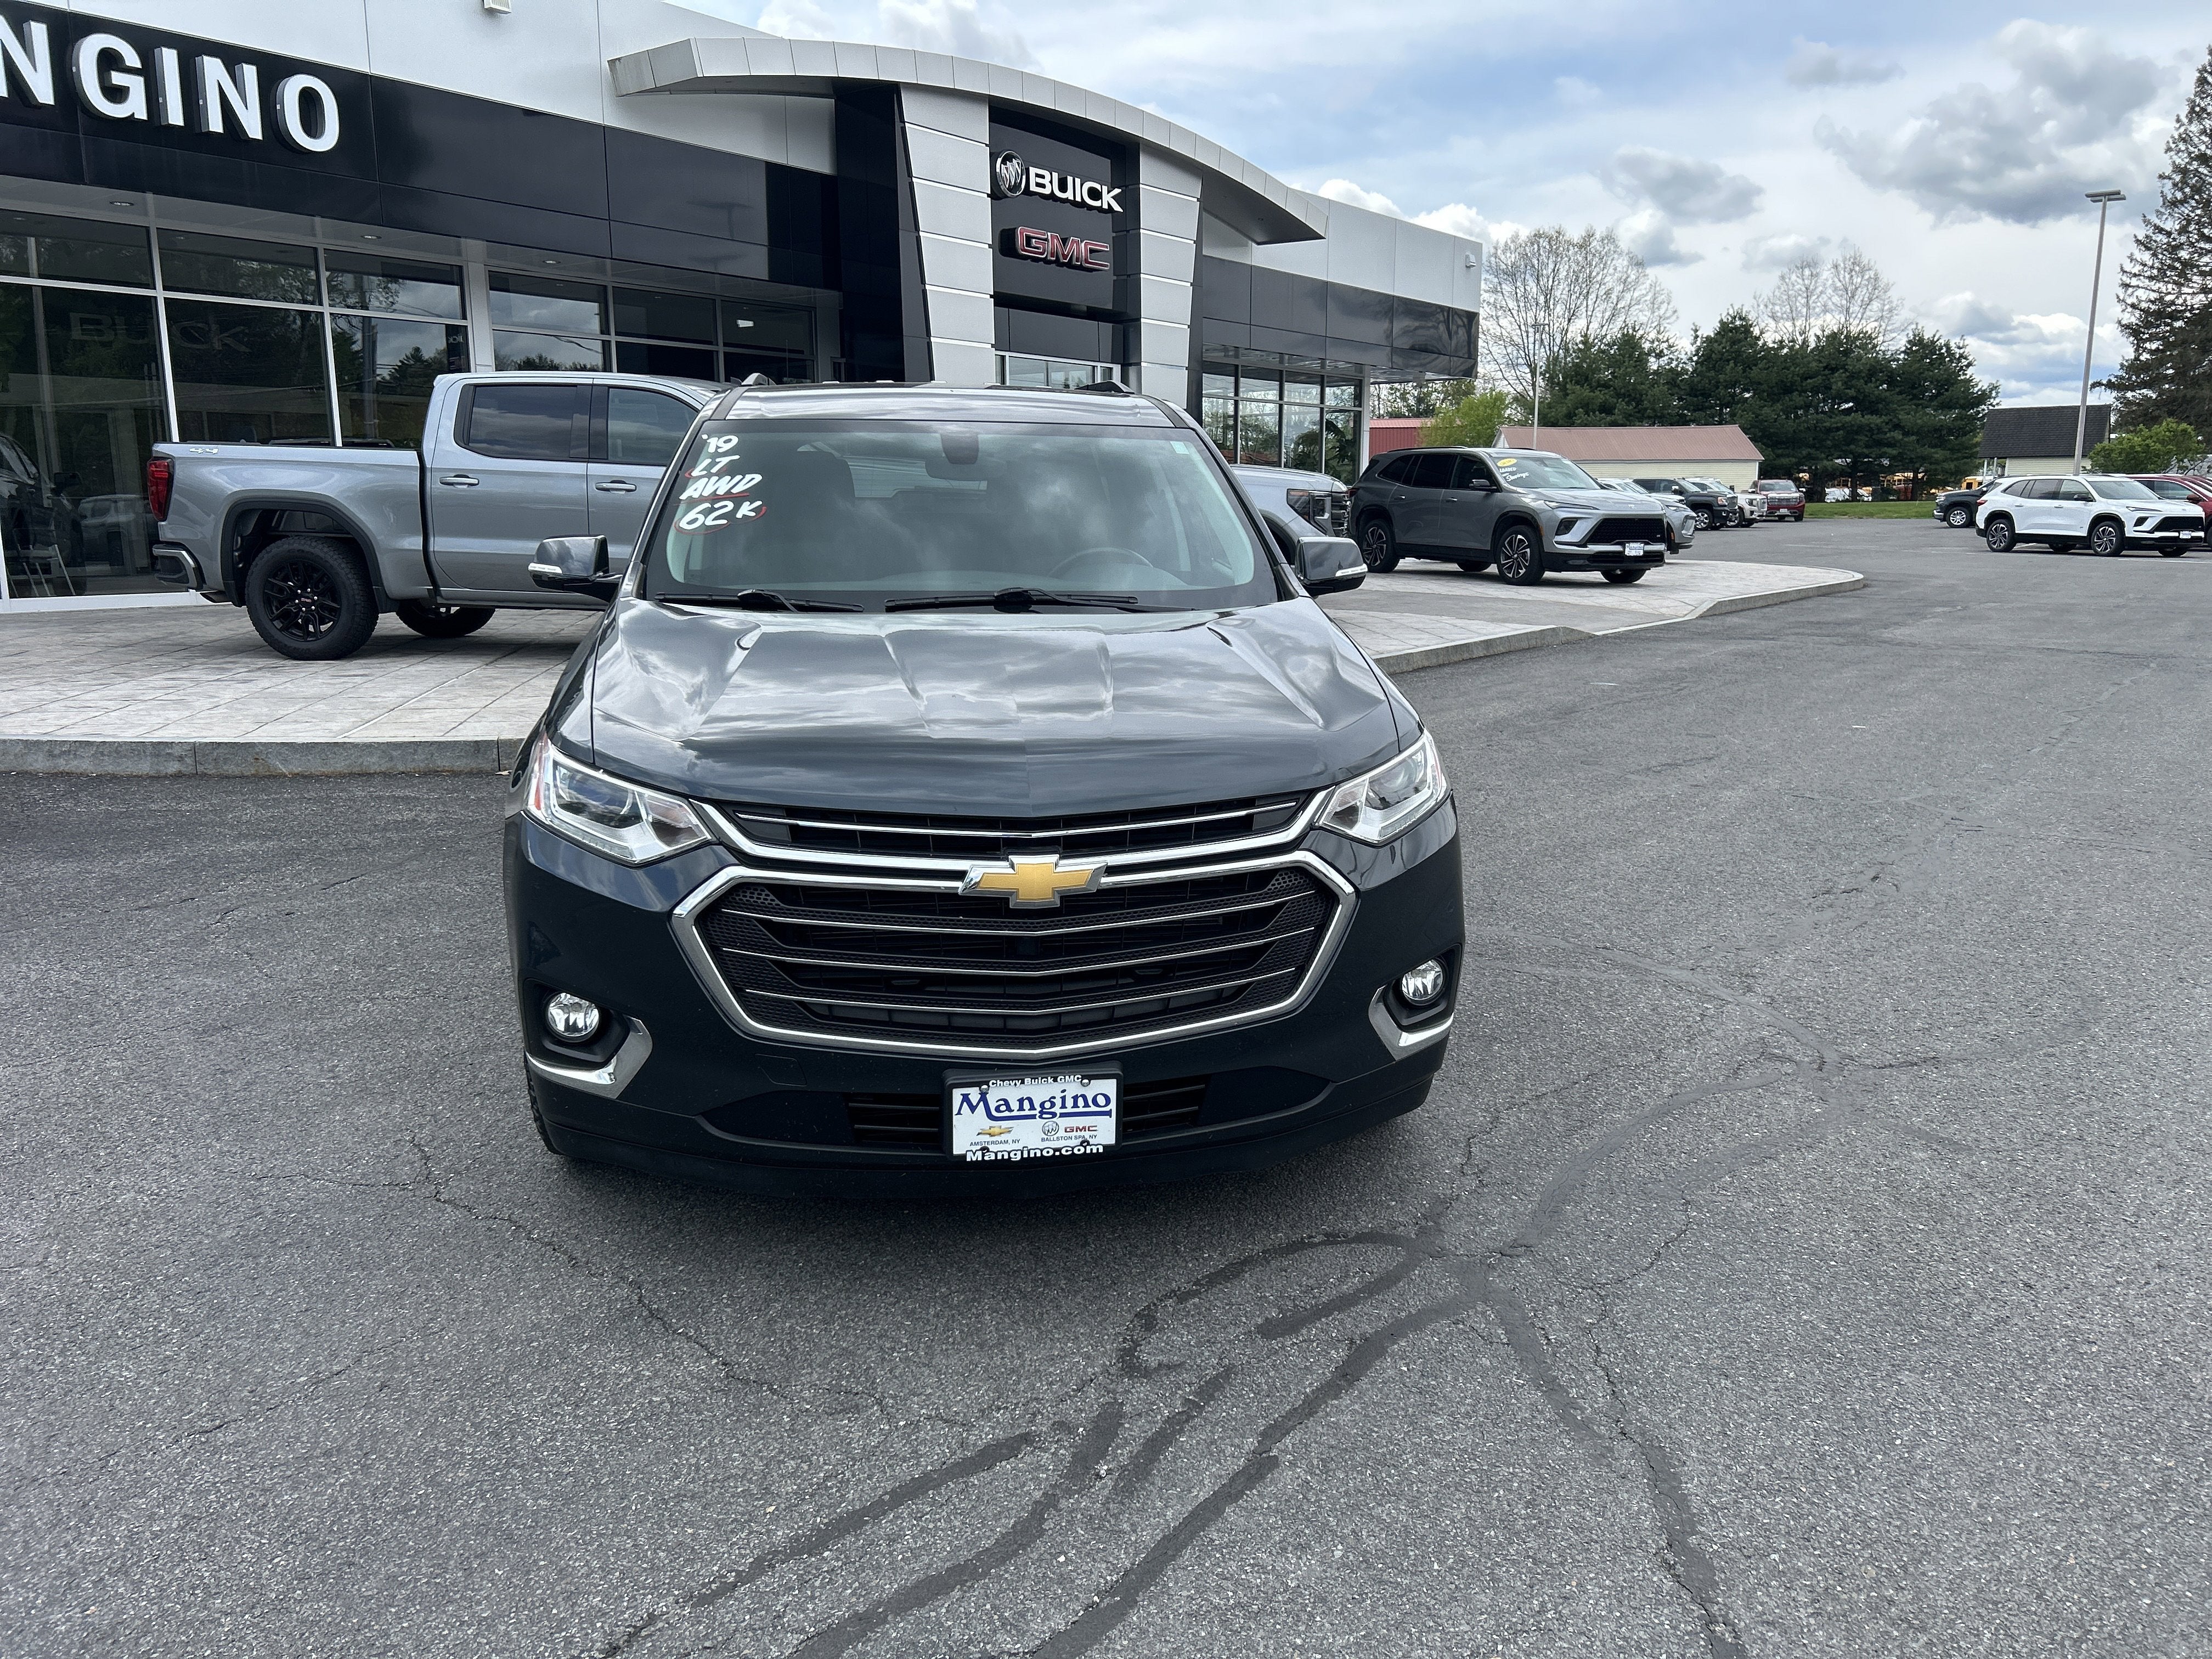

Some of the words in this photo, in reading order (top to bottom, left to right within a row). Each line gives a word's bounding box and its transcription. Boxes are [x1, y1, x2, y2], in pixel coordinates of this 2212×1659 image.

[1029, 166, 1123, 212] BUICK
[1018, 226, 1110, 270] GMC
[691, 455, 741, 477] LT
[679, 473, 763, 500] AWD
[989, 1079, 1022, 1088] Chevy
[1024, 1076, 1054, 1085] Buick
[1057, 1075, 1082, 1083] GMC
[955, 1088, 1113, 1122] Mangino
[1064, 1125, 1098, 1133] GMC
[966, 1143, 1103, 1161] Mangino.com
